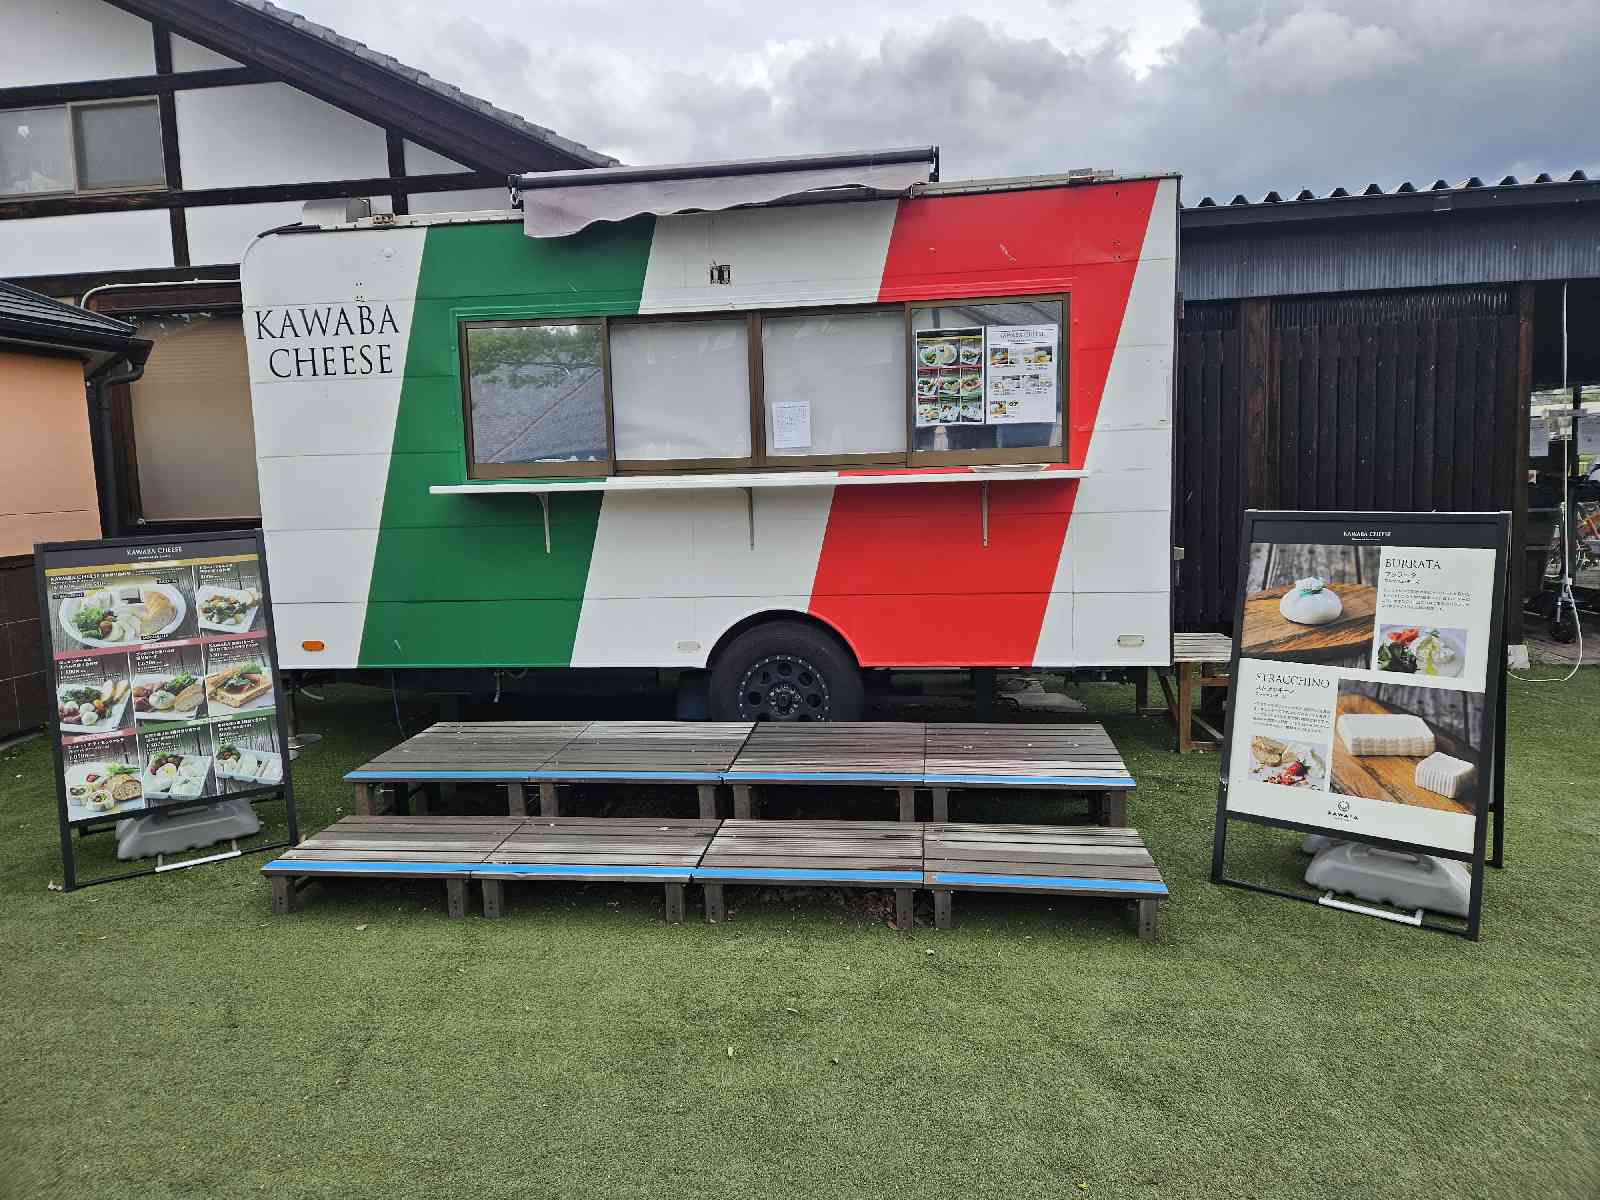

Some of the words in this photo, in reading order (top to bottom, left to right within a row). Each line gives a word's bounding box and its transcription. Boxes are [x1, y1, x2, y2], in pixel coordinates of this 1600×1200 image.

[254, 304, 400, 340] KAWABA
[269, 344, 393, 378] CHEESE
[157, 546, 182, 554] CHEESE
[1384, 558, 1442, 570] BURRATA
[1255, 672, 1330, 689] STRACCHINO
